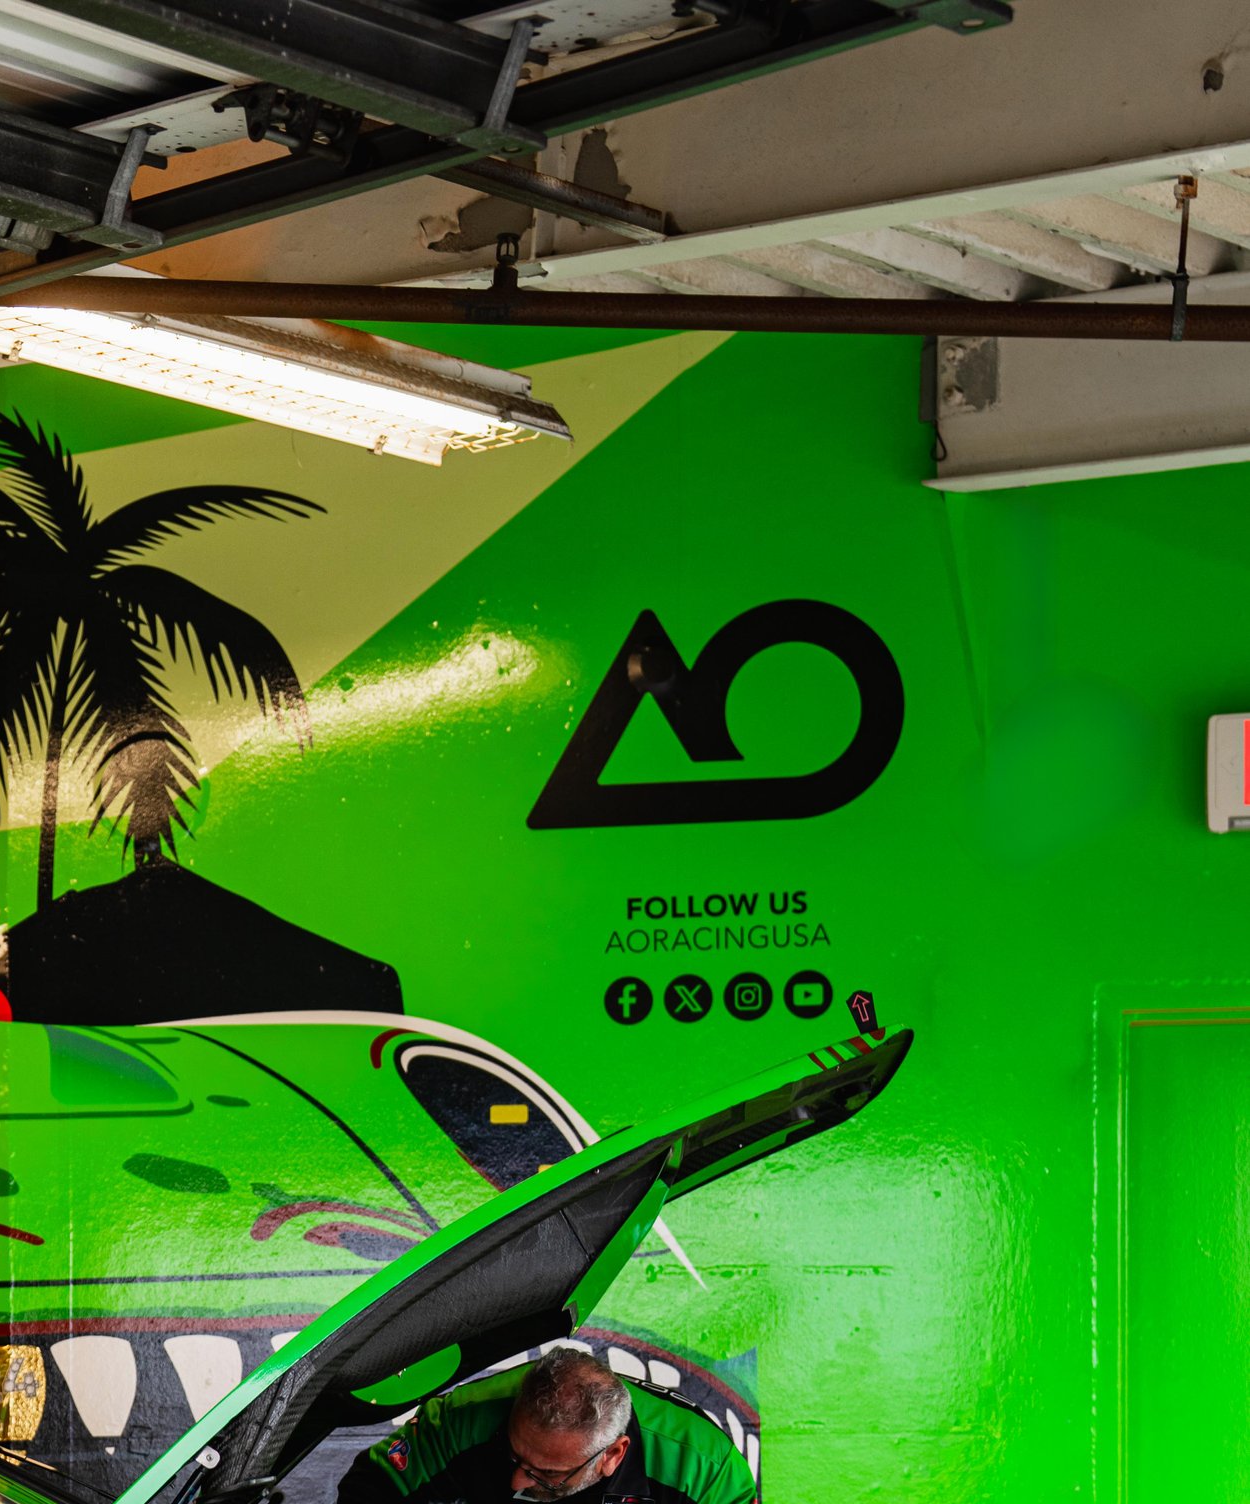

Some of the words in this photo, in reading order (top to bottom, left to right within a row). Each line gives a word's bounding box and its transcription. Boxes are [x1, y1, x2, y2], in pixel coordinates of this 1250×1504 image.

[626, 893, 760, 921] FOLLOW
[768, 891, 808, 916] US
[604, 923, 831, 954] AORACINGUSA
